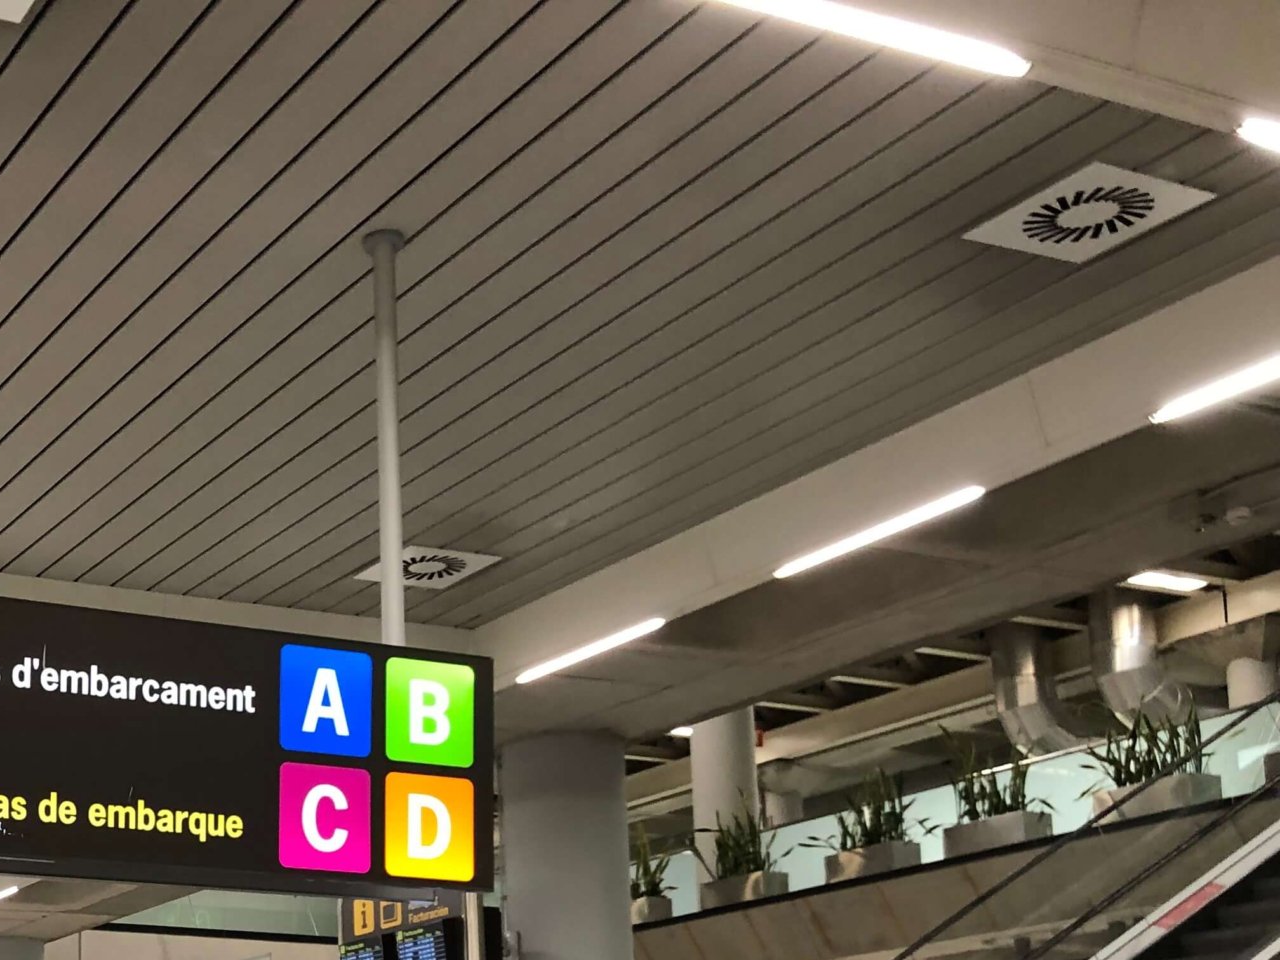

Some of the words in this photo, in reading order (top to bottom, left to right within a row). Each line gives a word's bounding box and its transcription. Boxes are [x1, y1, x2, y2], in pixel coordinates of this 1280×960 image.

[11, 656, 256, 714] d'embarcament
[301, 667, 350, 737] A
[409, 678, 451, 746] B
[37, 791, 77, 825] de
[87, 799, 244, 843] embarque
[301, 783, 349, 853] C
[407, 793, 452, 860] D
